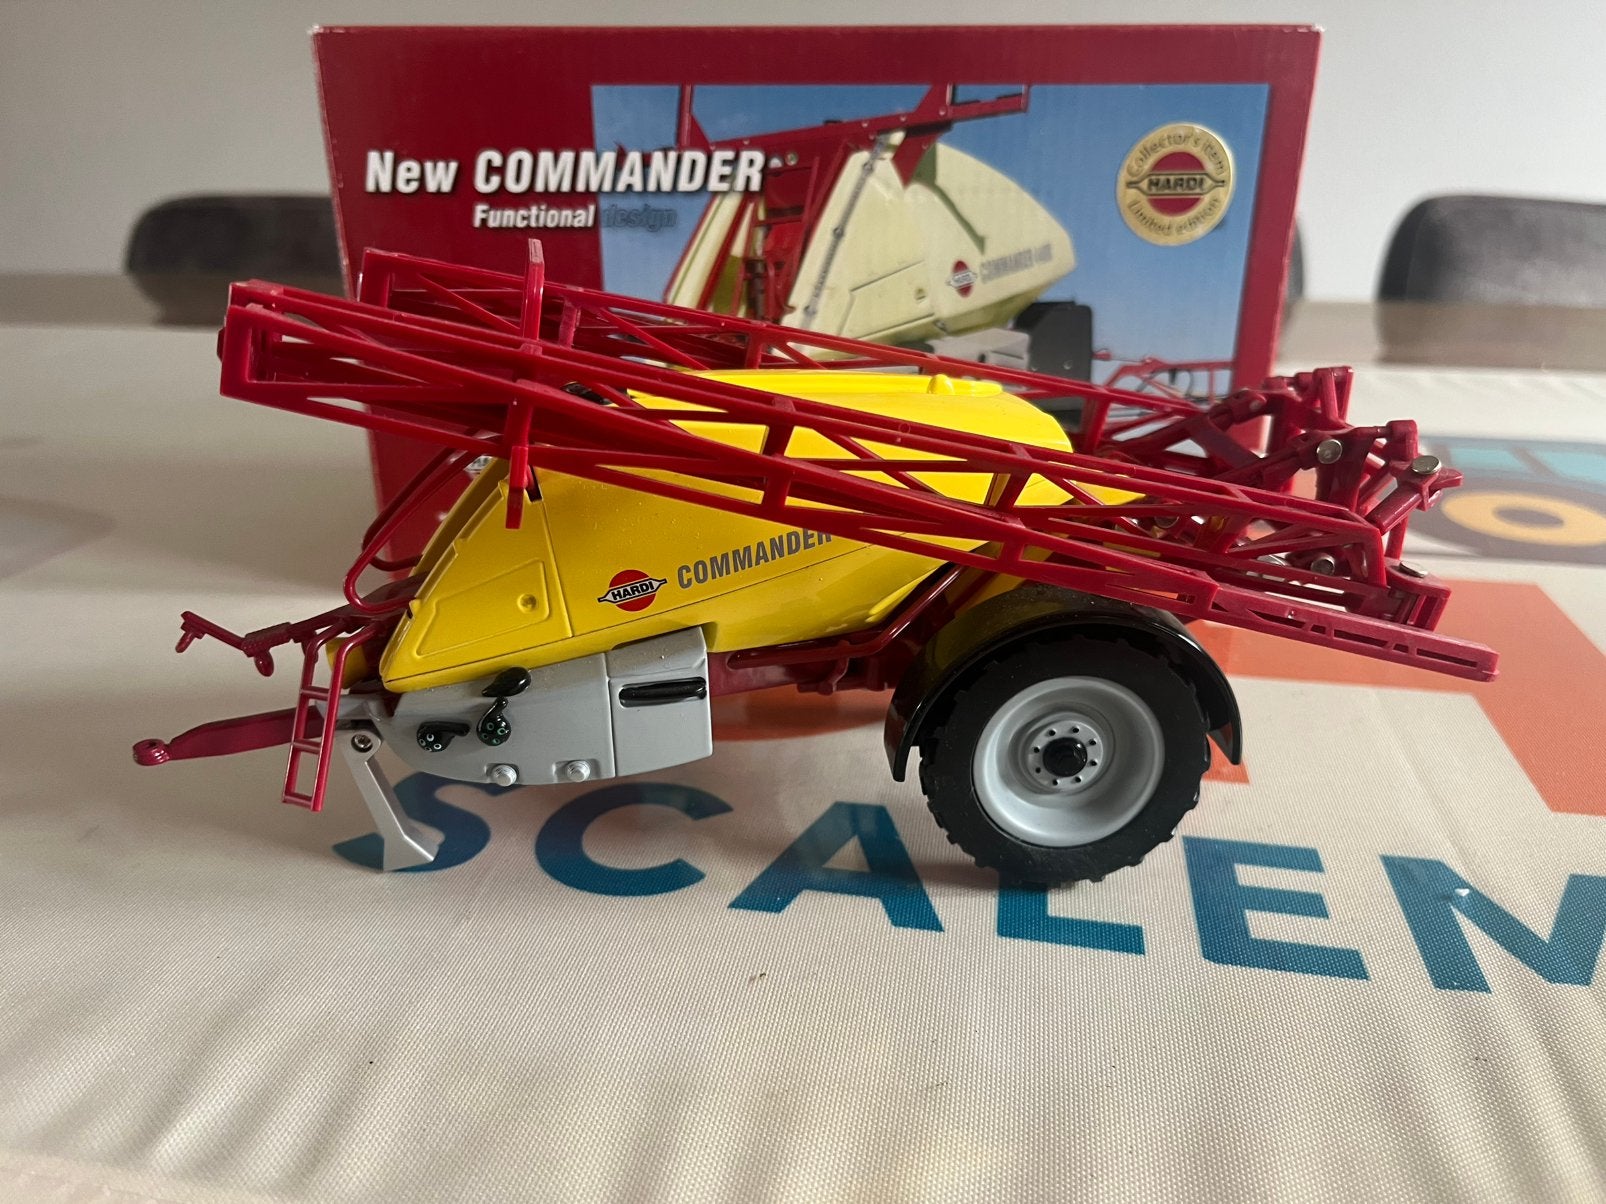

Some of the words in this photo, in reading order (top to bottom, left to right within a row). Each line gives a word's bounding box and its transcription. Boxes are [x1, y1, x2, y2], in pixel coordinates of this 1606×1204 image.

[365, 150, 459, 194] New
[473, 150, 766, 194] COMMANDER
[1147, 177, 1205, 192] HARDI
[473, 203, 596, 229] Functional
[611, 580, 656, 601] HARDI
